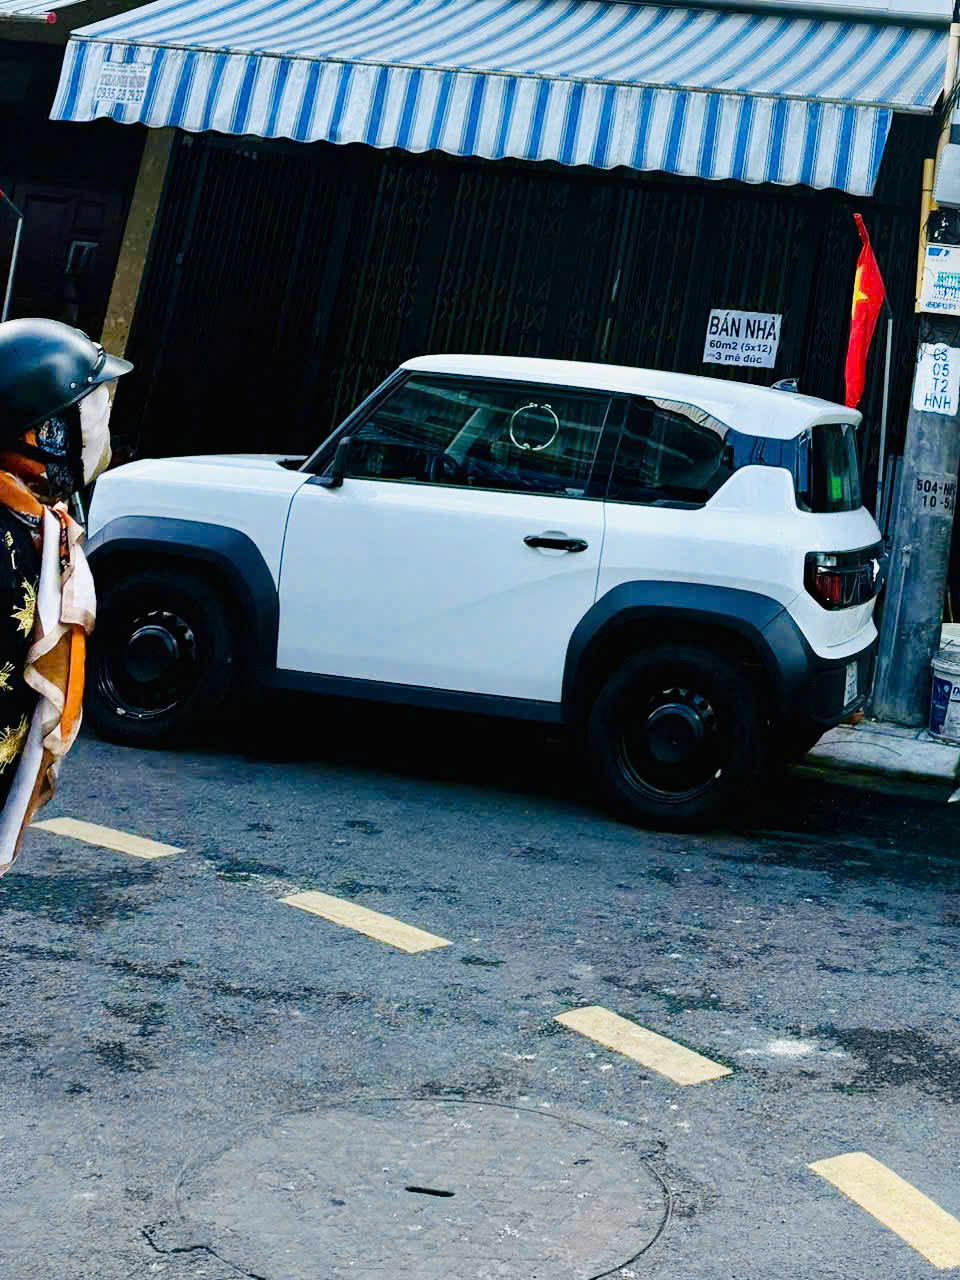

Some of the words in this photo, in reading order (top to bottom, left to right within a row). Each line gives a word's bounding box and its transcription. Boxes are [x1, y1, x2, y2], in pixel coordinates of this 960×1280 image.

[709, 312, 742, 338] BÁN
[745, 316, 777, 340] NHÀ
[709, 339, 738, 350] 60m2
[740, 343, 773, 355] (5x12)
[933, 377, 949, 393] T2
[924, 392, 952, 409] HNH
